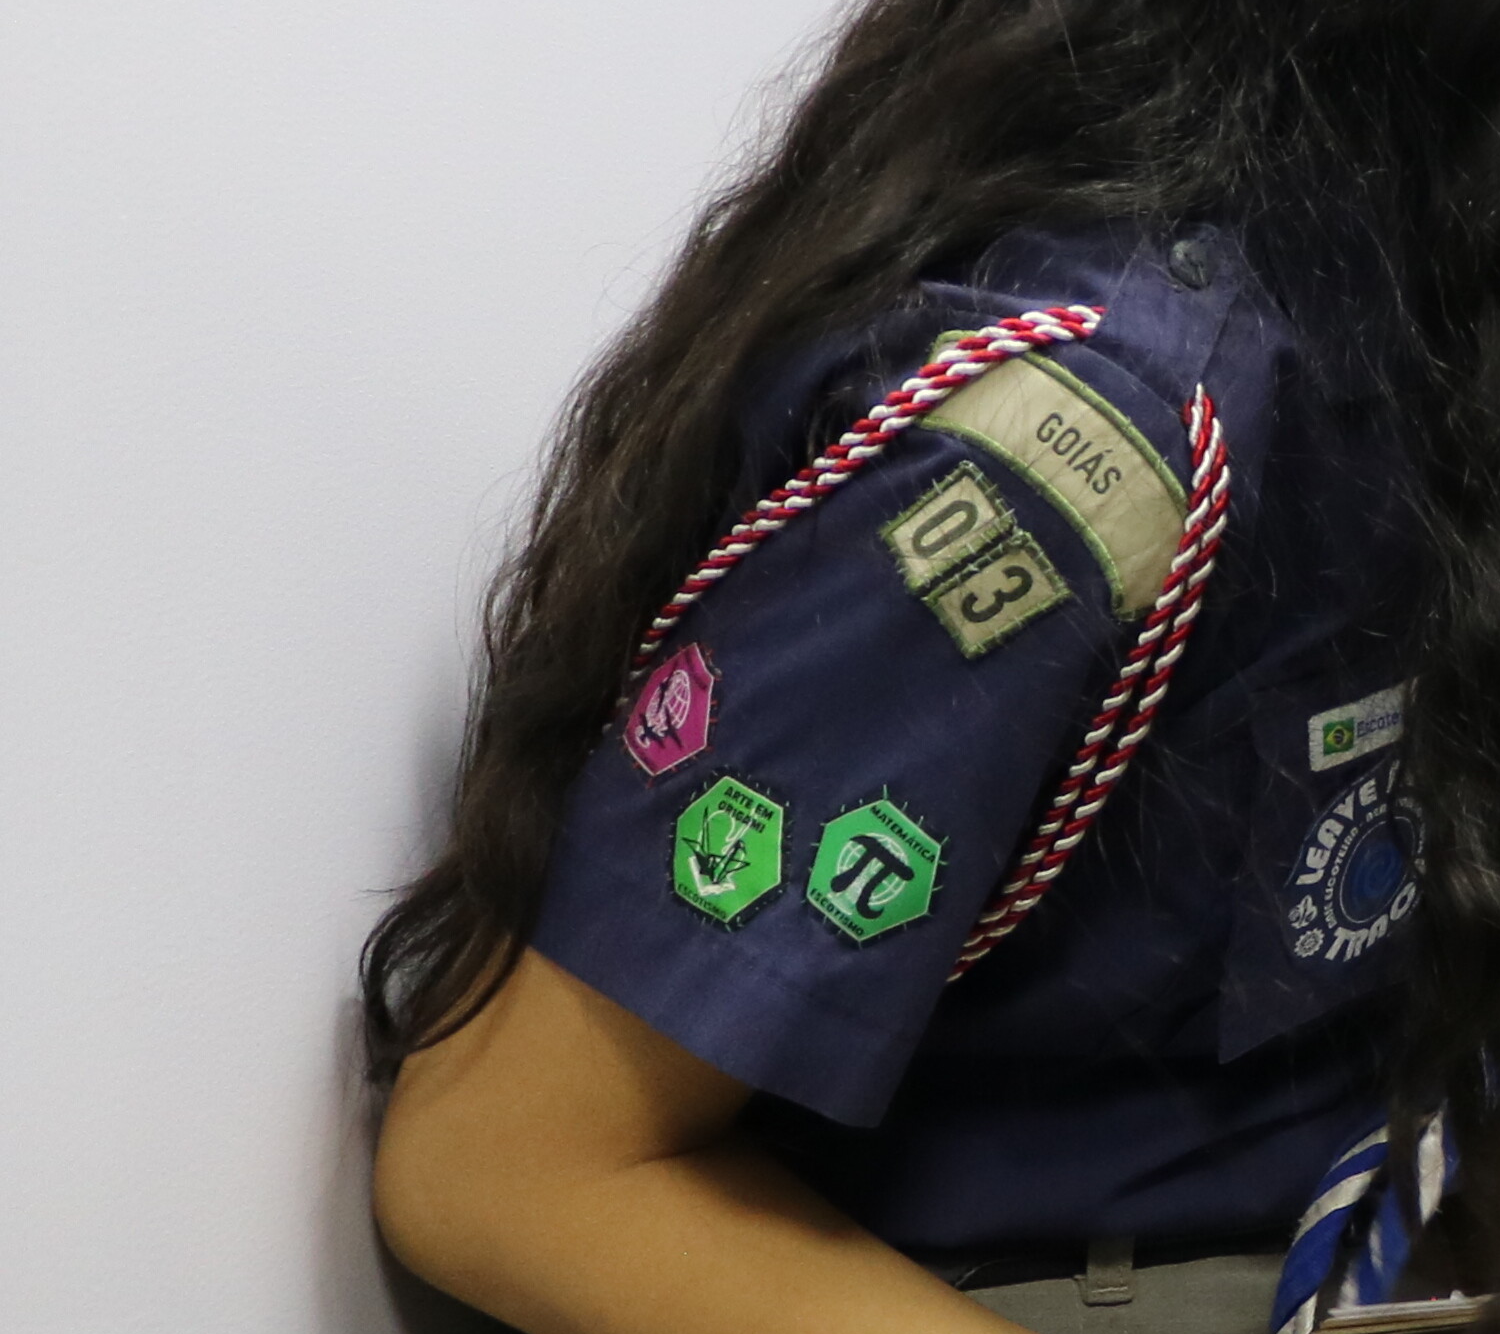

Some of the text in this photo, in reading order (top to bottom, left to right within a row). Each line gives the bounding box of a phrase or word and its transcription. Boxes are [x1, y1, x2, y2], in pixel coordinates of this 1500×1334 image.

[1036, 413, 1122, 495] GOIÁS
[718, 800, 766, 835] ORIGAMI
[724, 786, 775, 821] ARTE EM
[1296, 778, 1378, 886] LEAVE
[809, 887, 865, 937] ESCOTISMO
